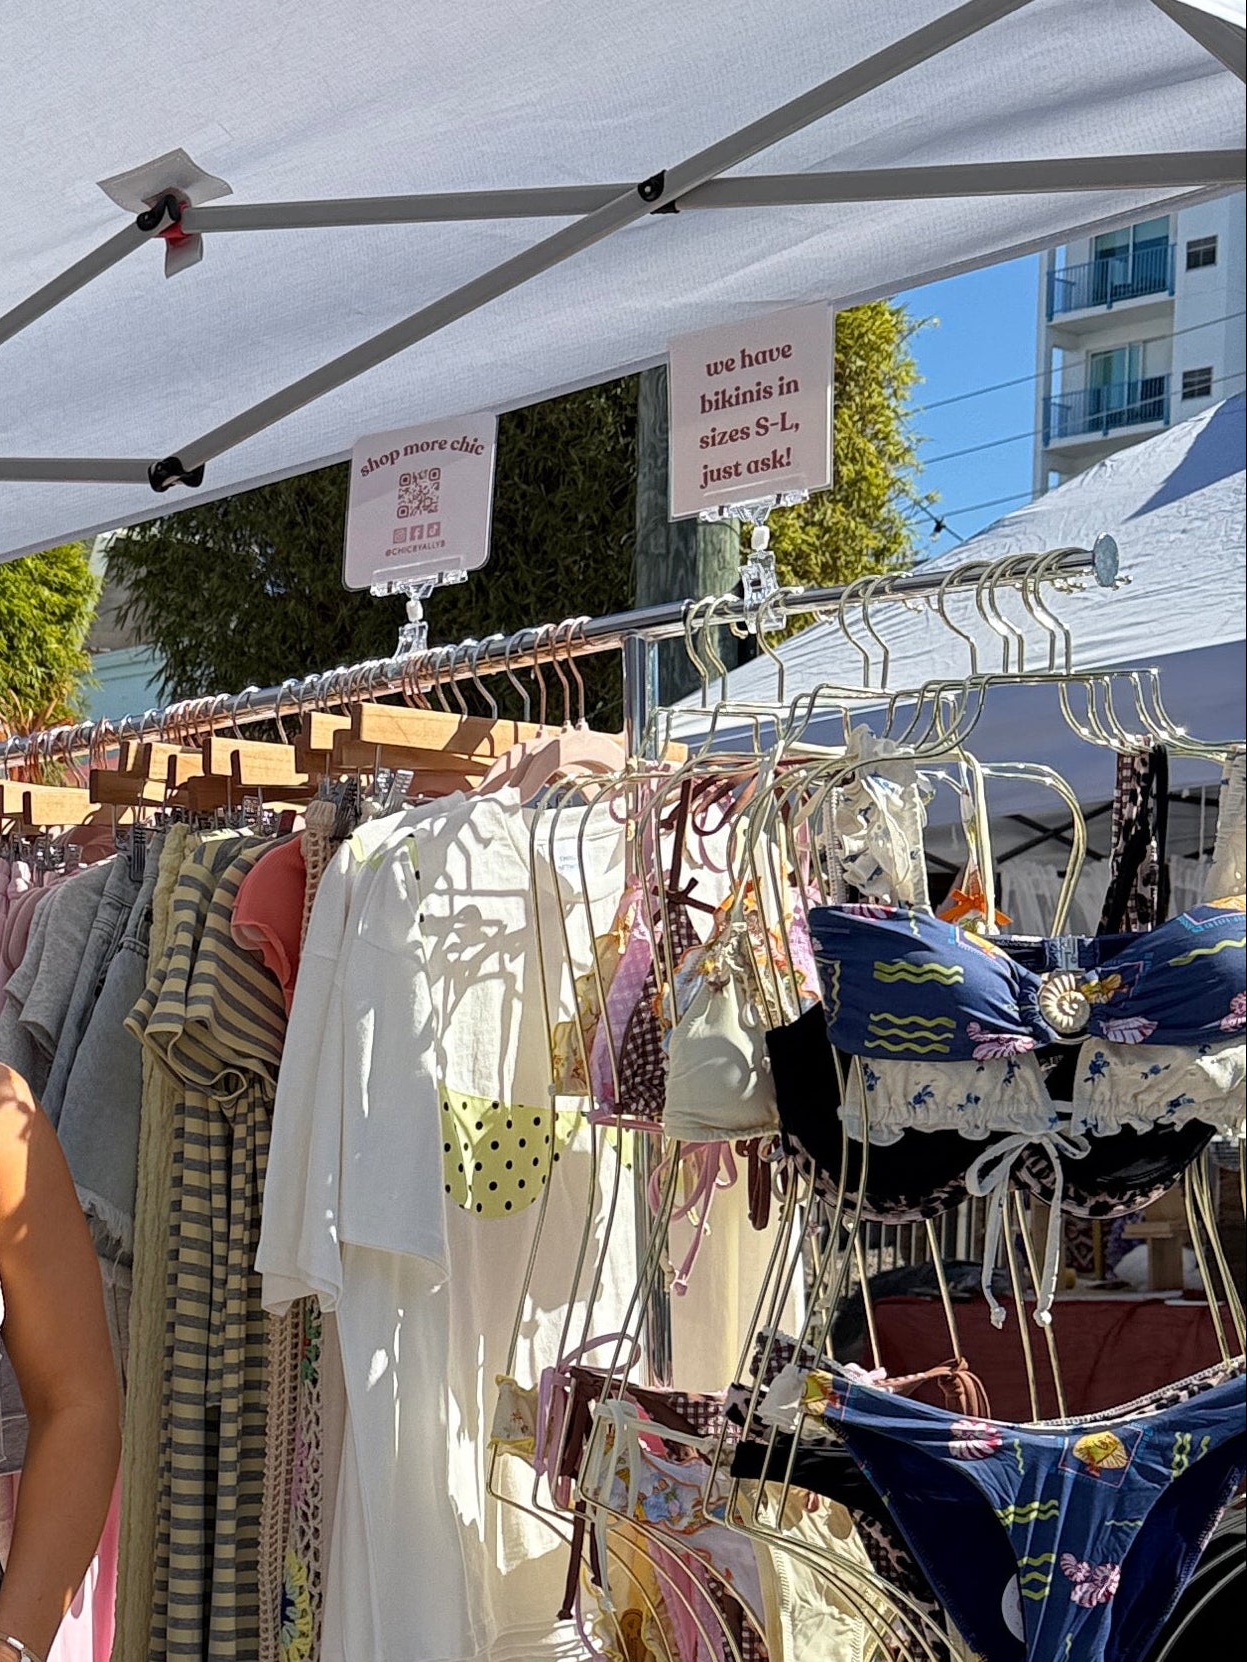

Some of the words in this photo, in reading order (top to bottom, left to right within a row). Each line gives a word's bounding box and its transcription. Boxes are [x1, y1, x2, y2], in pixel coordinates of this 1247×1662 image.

[706, 357, 736, 377] we
[740, 344, 793, 369] have
[700, 381, 773, 414] bikinis
[778, 375, 800, 396] in
[360, 449, 400, 477] shop
[404, 438, 448, 456] more
[450, 436, 485, 456] chic
[699, 427, 751, 450] sizes
[699, 460, 743, 489] just
[746, 447, 792, 475] ask!
